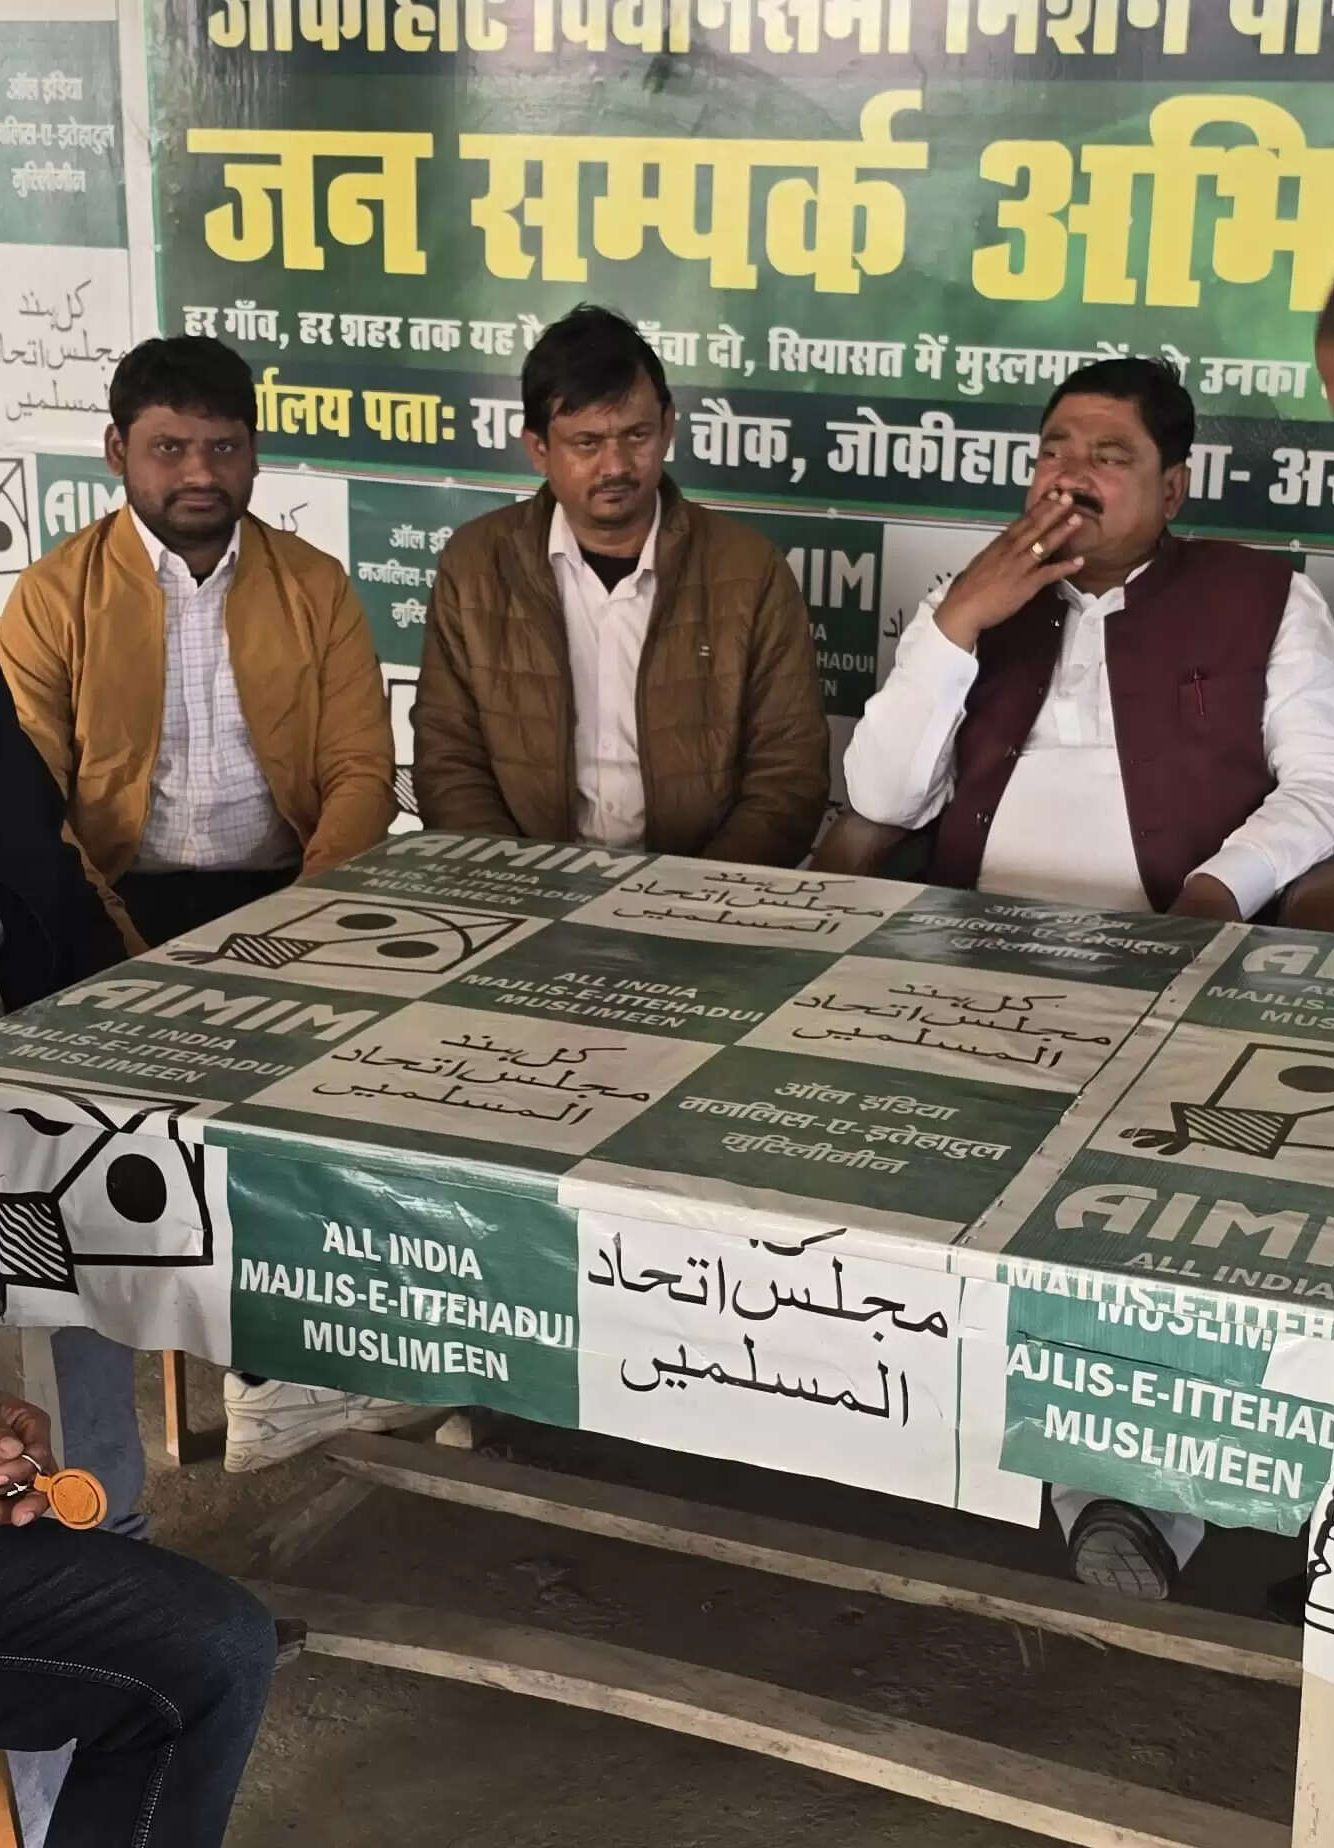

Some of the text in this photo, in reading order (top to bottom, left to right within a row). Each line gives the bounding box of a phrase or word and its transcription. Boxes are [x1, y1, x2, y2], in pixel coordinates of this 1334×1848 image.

[187, 129, 434, 275] जन
[459, 89, 928, 294] सम्पर्क
[182, 306, 218, 338] हर
[298, 312, 334, 345] हर
[340, 314, 402, 349] शहर
[408, 317, 461, 351] तक
[469, 320, 517, 355] यह
[706, 324, 755, 377] दो,
[768, 326, 906, 378] सियासत
[915, 333, 949, 380] में
[1200, 356, 1310, 399] उनका
[690, 398, 806, 483] चौक,
[390, 524, 425, 549] ऑल
[387, 834, 648, 878] AIMIM
[420, 862, 540, 885] ALL INDIA
[363, 878, 524, 905] MUSLIMEEN
[553, 972, 698, 999] ALL INDIA
[57, 979, 379, 1042] AIMIM
[495, 993, 686, 1028] MUSLIMEEN
[87, 1019, 238, 1052] ALL INDIA
[7, 1043, 208, 1084] MUSLIMEEN
[774, 1081, 960, 1121] ऑल इंडिया
[322, 1220, 483, 1281] ALL INDIA
[1122, 1252, 1202, 1277] ALL
[587, 1232, 948, 1342] مجلس اتحاد
[304, 1318, 509, 1382] MUSLIMEEN
[1044, 1404, 1304, 1499] MUSLIMEEN
